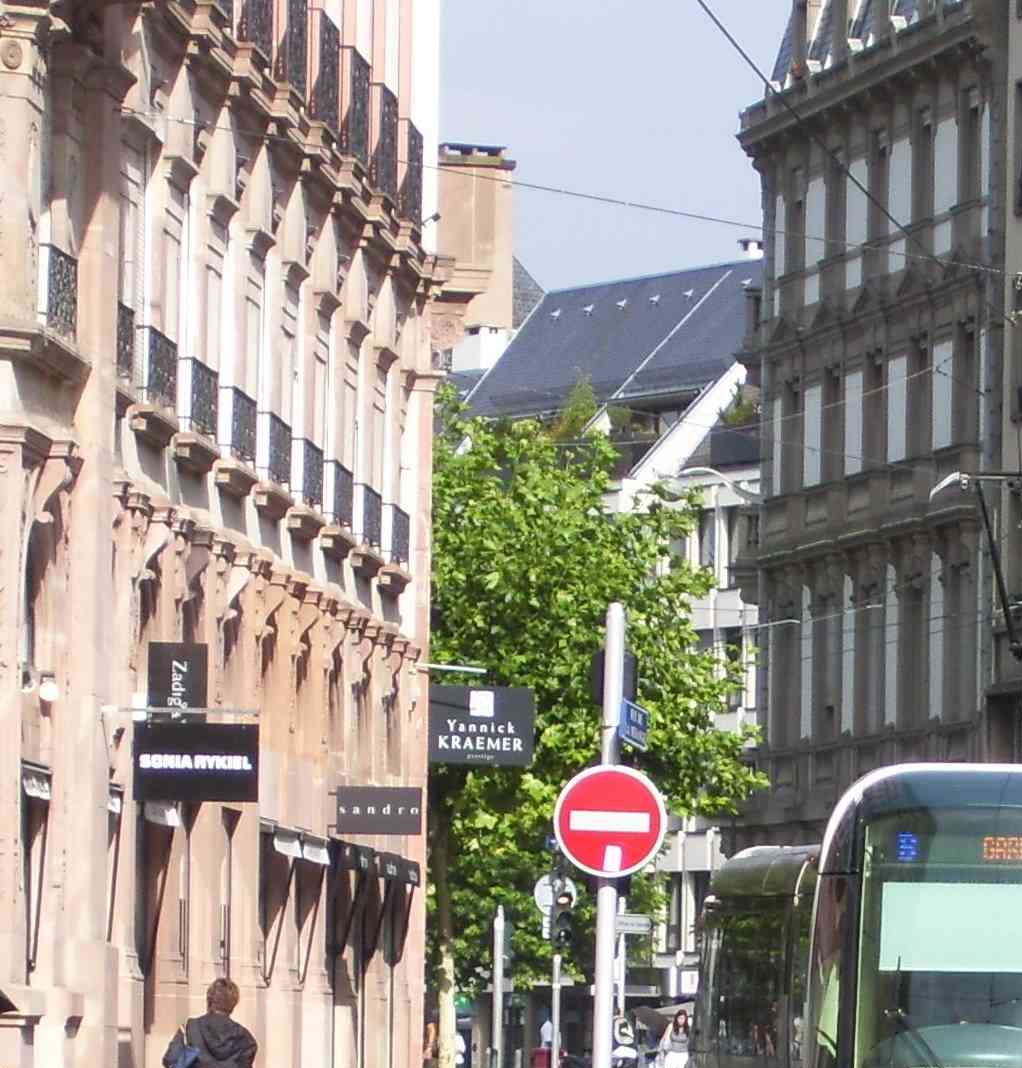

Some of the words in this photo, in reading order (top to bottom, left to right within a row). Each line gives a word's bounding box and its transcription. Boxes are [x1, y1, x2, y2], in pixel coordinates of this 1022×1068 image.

[167, 660, 188, 705] Zadig
[446, 718, 515, 734] Yannick
[438, 735, 523, 752] KRAEMER
[139, 754, 193, 769] SONIA
[194, 754, 252, 770] RYKIEL
[339, 803, 419, 815] sandro
